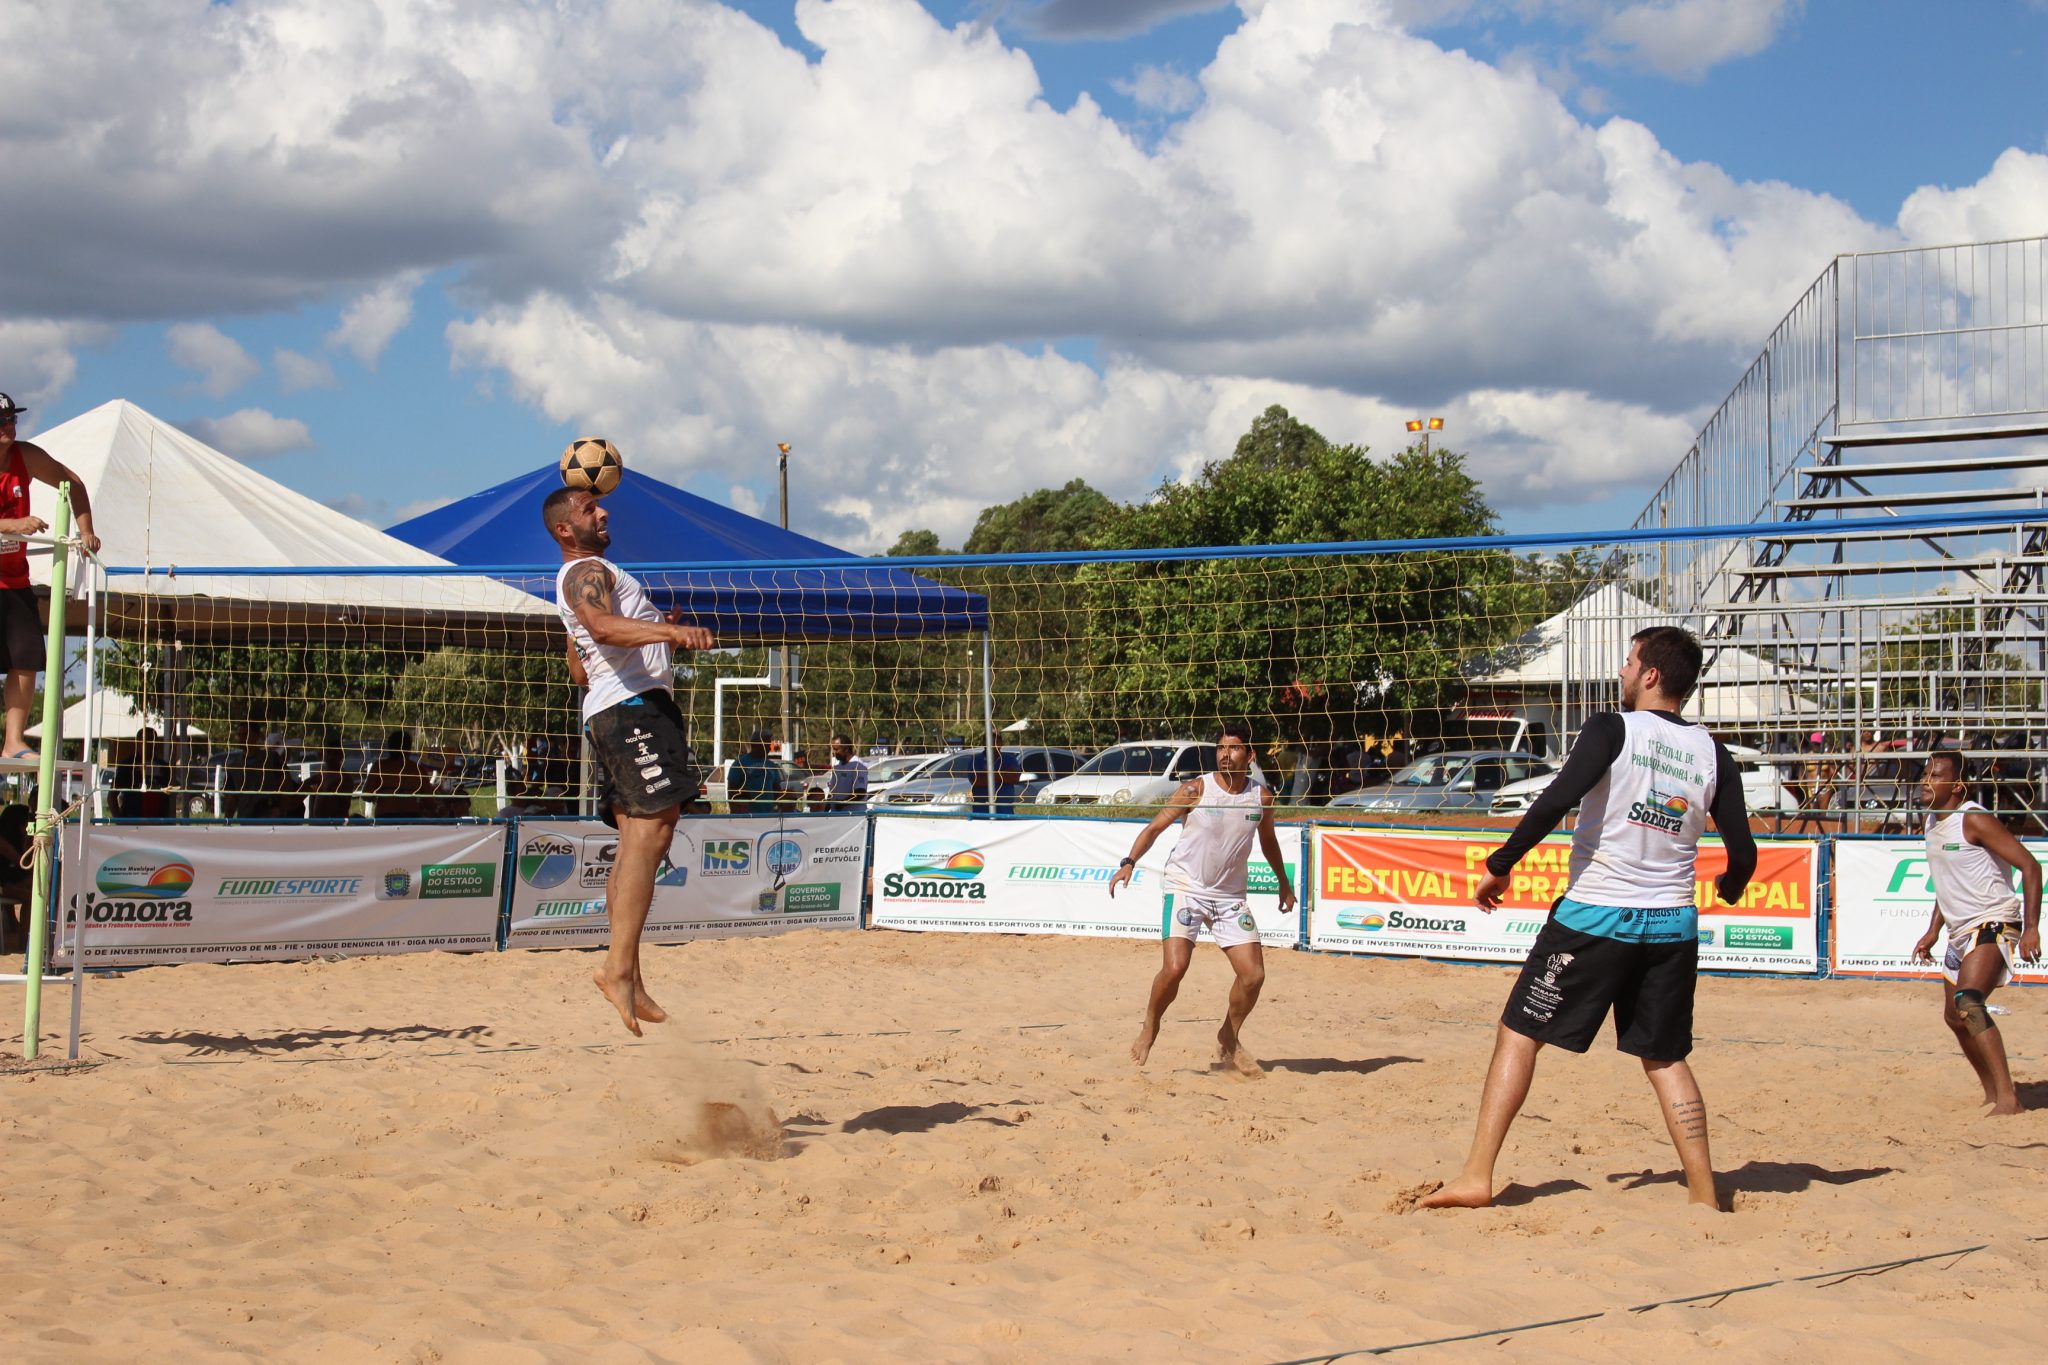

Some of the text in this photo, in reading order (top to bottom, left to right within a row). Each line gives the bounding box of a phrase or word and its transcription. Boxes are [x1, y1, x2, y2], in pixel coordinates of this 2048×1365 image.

[1685, 753, 1694, 766] DE
[1661, 762, 1688, 782] SONORA
[1628, 802, 1683, 832] Sonora
[704, 842, 750, 870] MS
[815, 846, 859, 854] FEDERAÇÃO
[429, 867, 476, 877] GOVERNO
[217, 879, 362, 895] FUNDESPORTE
[428, 877, 482, 886] DO ESTADO
[883, 873, 986, 899] Sonora
[1327, 867, 1457, 899] FESTIVAL
[1513, 875, 1570, 902] PRA
[790, 886, 826, 894] GOVERNO
[1880, 909, 1930, 917] FUNDA
[552, 928, 611, 936] INVESTIMENTO
[734, 920, 768, 928] DENÚNCIA
[1388, 911, 1466, 932] Sonora
[110, 947, 188, 955] INVESTIMENTOS
[306, 942, 339, 950] DISQUE
[341, 939, 384, 948] DENÚNCIA
[460, 936, 491, 944] DROGAS
[1367, 940, 1443, 950] INVESTIMENTOS
[1446, 945, 1507, 953] ESPORTIVOS
[1547, 959, 1563, 973] Life
[1549, 954, 1563, 964] All
[1841, 959, 1879, 967] FUNDO
